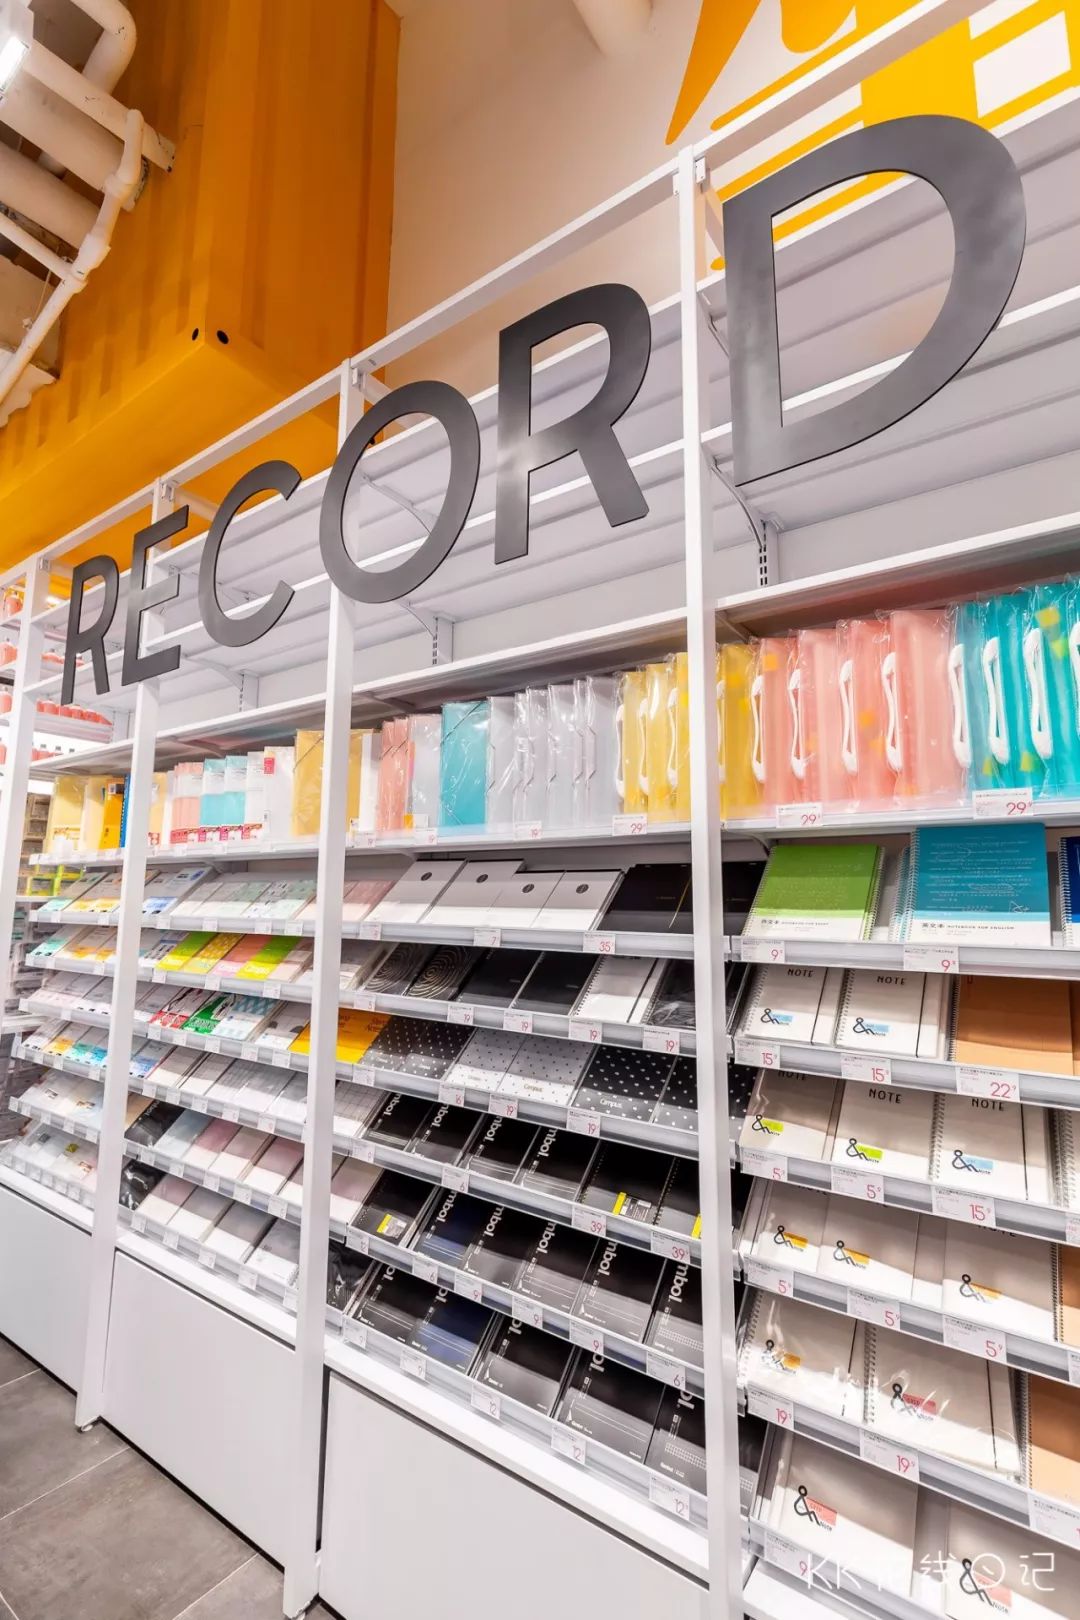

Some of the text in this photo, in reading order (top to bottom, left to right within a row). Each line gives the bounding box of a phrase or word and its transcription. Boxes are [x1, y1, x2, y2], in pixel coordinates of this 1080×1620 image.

[61, 114, 1027, 705] RECORD
[787, 968, 815, 979] NOTE
[877, 975, 908, 986] NOTE
[523, 1082, 545, 1094] Campus
[599, 1096, 624, 1110] Campus
[868, 1088, 904, 1105] NOTE
[971, 1097, 1006, 1112] NOTE
